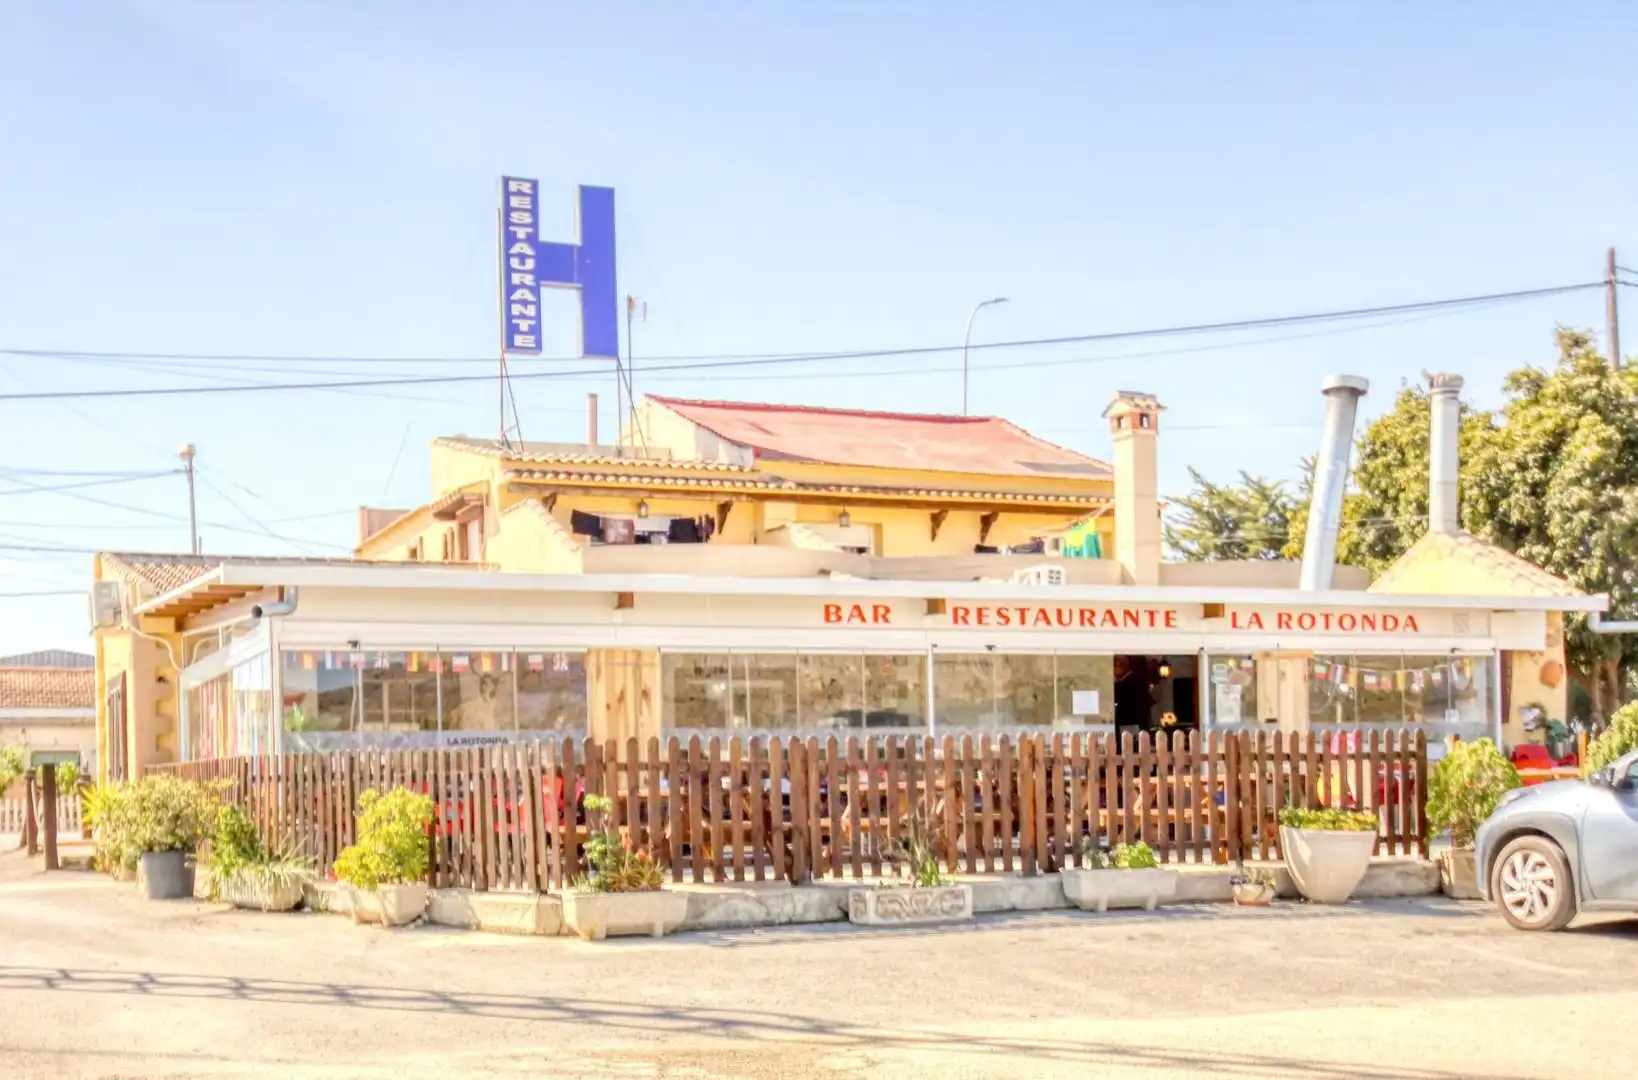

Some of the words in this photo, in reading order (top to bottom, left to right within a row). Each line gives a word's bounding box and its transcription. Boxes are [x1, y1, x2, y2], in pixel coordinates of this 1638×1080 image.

[508, 180, 536, 348] RESTAURANTE
[823, 603, 892, 624] BAR
[952, 606, 1178, 629] RESTAURANTE
[1231, 611, 1265, 630] LA
[1277, 611, 1420, 633] ROTONDA
[447, 737, 459, 746] LA
